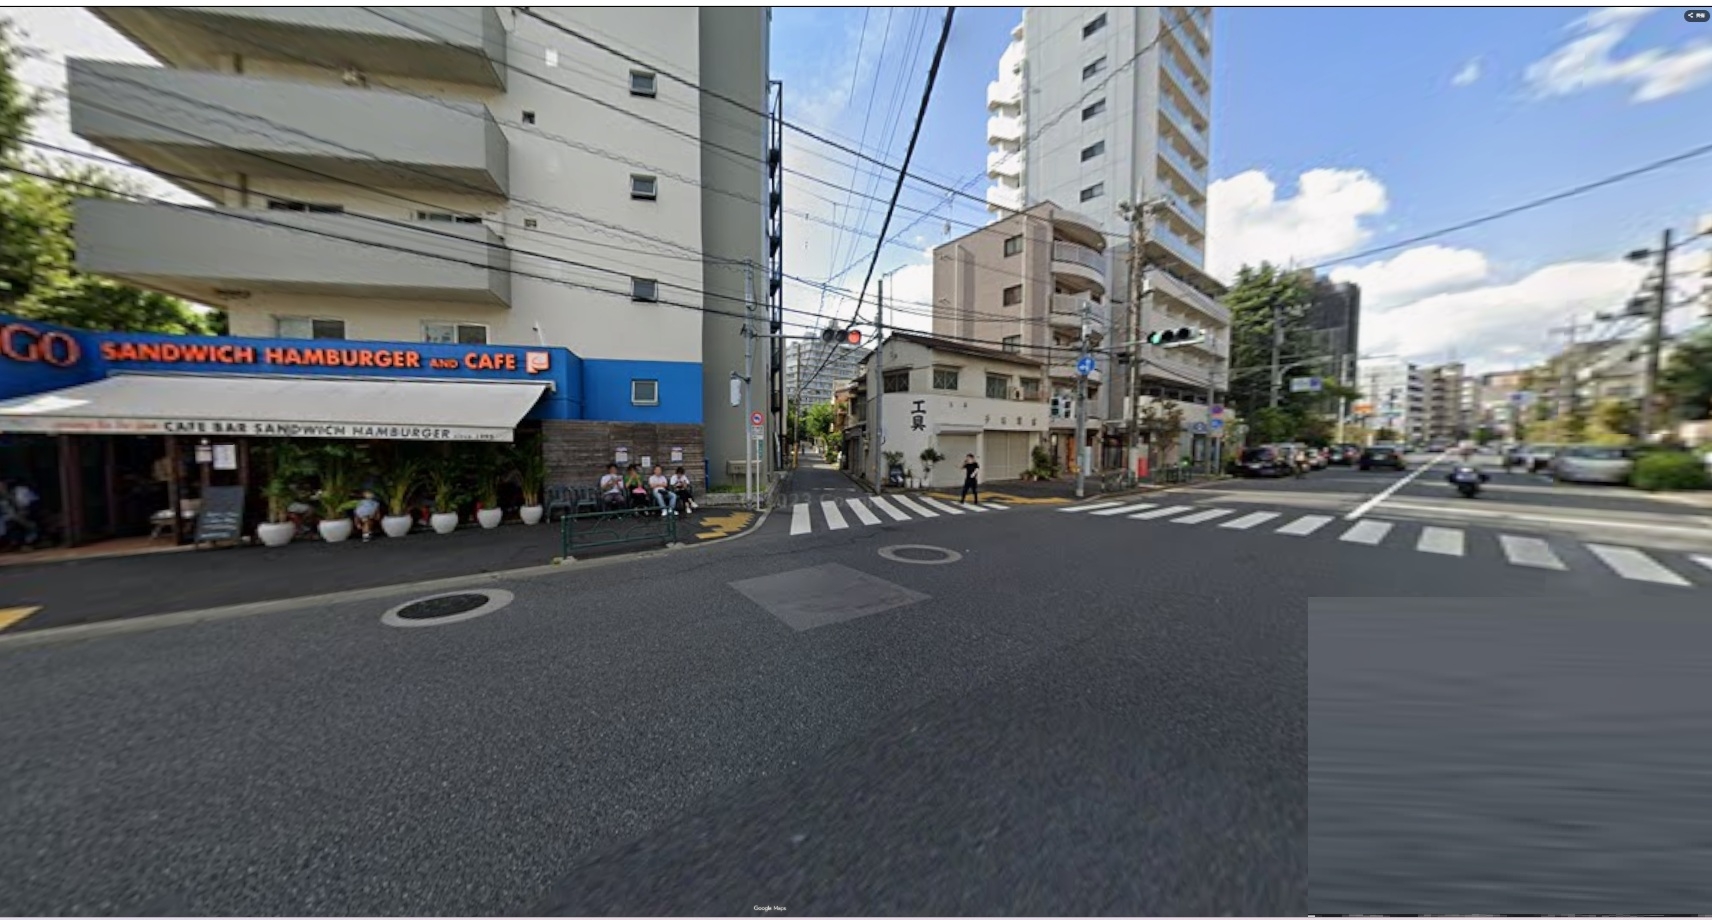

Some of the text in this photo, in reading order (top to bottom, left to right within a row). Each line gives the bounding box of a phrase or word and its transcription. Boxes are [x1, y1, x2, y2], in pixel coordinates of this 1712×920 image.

[101, 342, 516, 371] SANDWICH HAMBURGER AND CAFE
[910, 399, 927, 432] 工具
[164, 422, 206, 433] CAFE
[215, 422, 247, 434] BAR
[254, 423, 346, 436] SANDWICH
[352, 426, 451, 440] HAMBURGER
